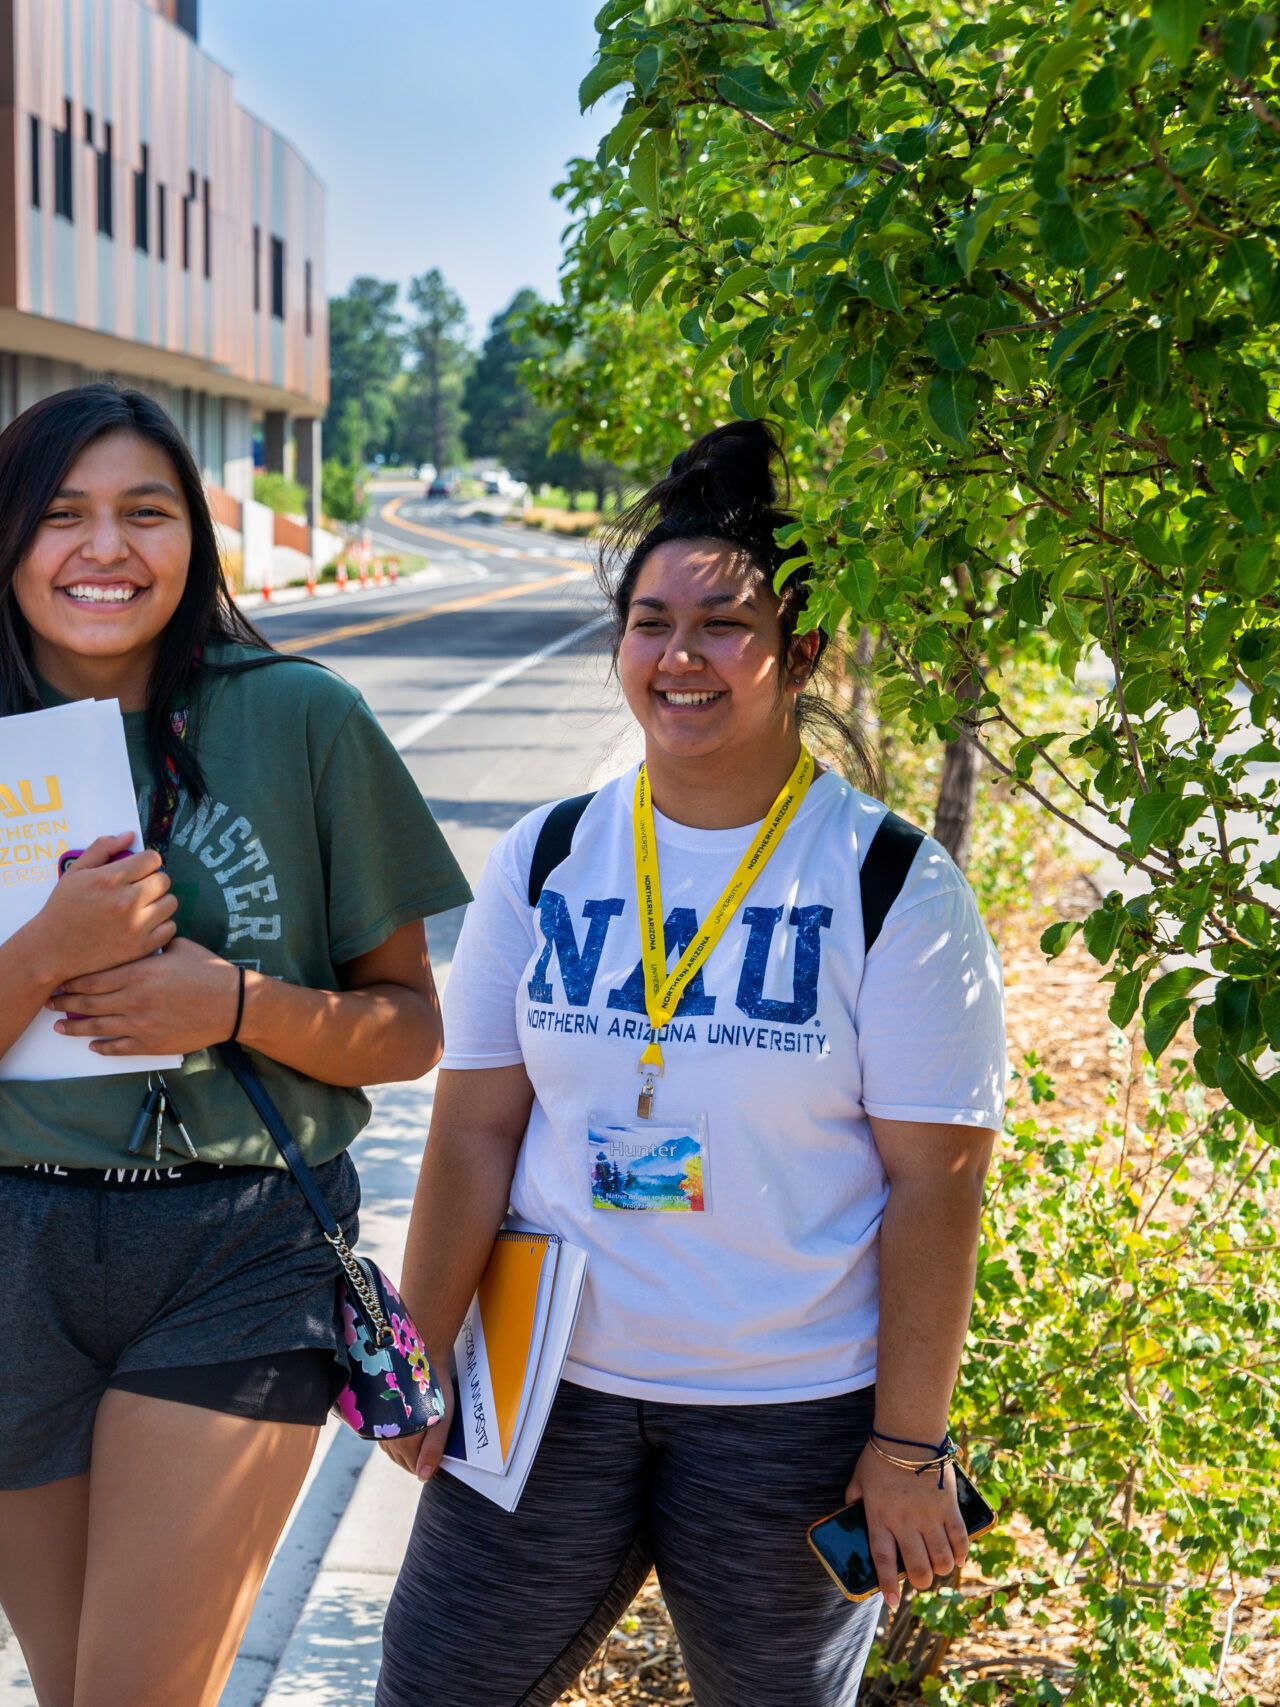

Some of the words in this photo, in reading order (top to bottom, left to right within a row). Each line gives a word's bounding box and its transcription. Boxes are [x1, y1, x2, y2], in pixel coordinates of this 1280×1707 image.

[747, 827, 775, 870] NORTHERN
[773, 795, 795, 828] ARIZONA
[644, 875, 653, 916] NORTHERN
[527, 889, 834, 1026] NAU
[648, 917, 657, 951] ARIZONA
[661, 967, 689, 1009] NORTHERN
[687, 935, 711, 968] ARIZONA
[526, 1007, 599, 1035] NORTHERN
[608, 1018, 696, 1043] ARIZONA
[708, 1024, 827, 1054] UNIVERSITY
[609, 1141, 677, 1157] Hunter
[606, 1192, 627, 1200] Native
[470, 1373, 488, 1452] UNIVERSITY
